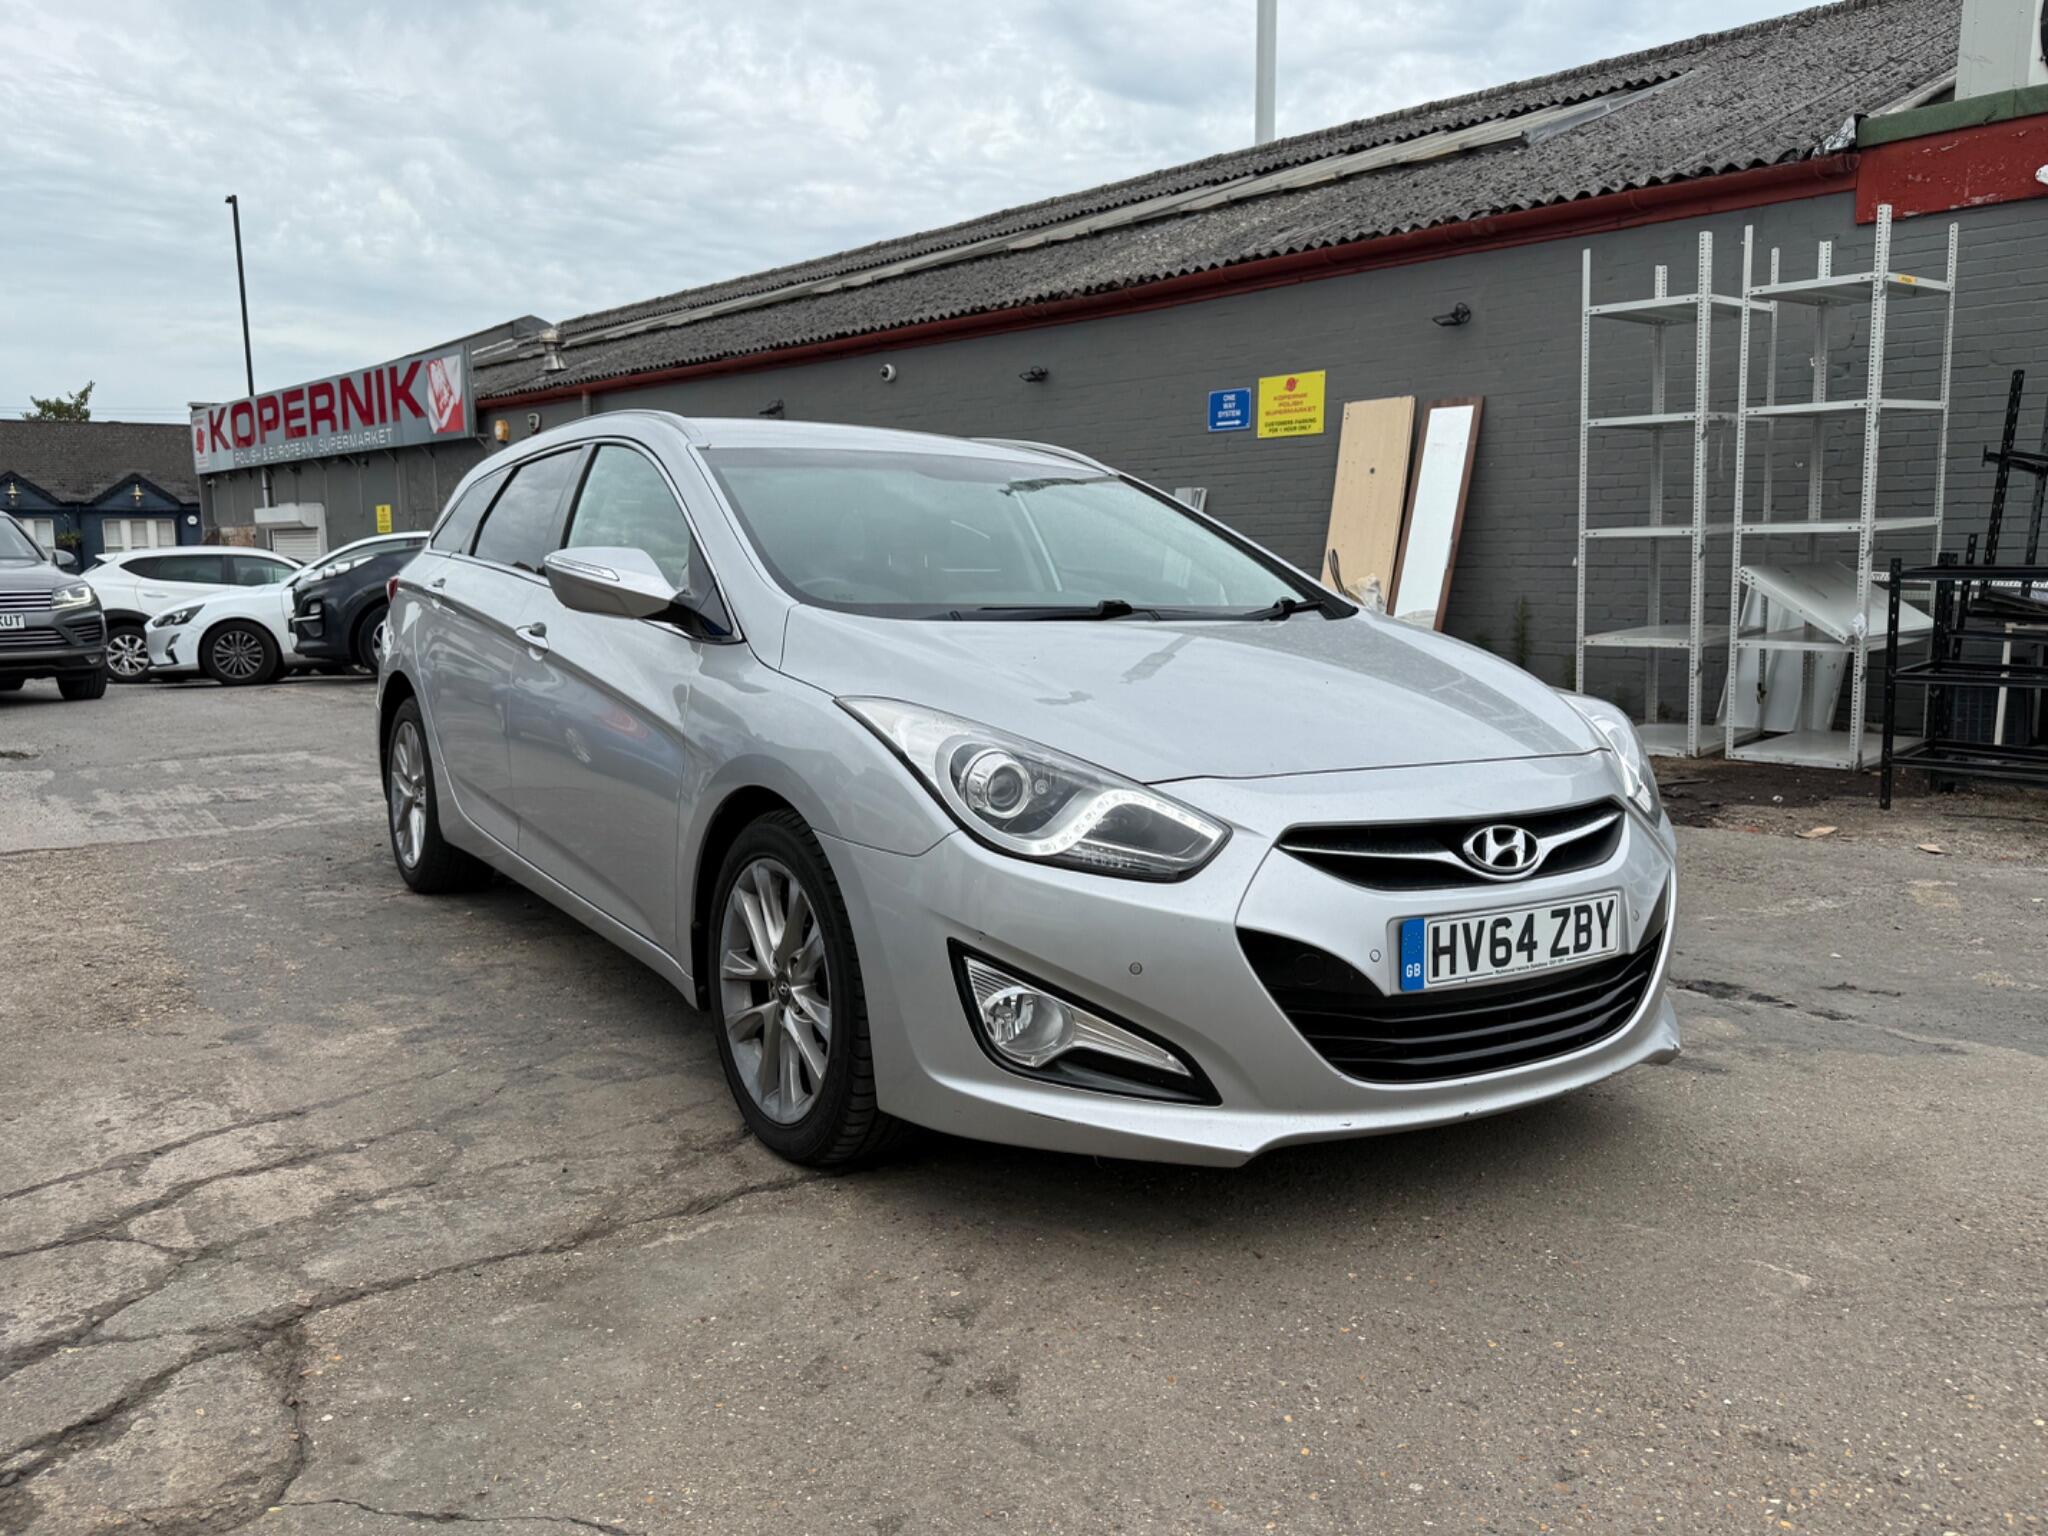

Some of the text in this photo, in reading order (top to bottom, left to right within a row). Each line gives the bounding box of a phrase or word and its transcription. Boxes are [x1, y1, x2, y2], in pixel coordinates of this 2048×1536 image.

[208, 360, 427, 453] KOPERNIK
[1217, 410, 1241, 418] SYSTEM
[235, 449, 261, 464] POLISH
[269, 440, 314, 460] EUROPEAN
[319, 428, 392, 453] SUPERMARKET
[1432, 900, 1614, 977] HV64 ZBY
[1406, 963, 1421, 977] GB
